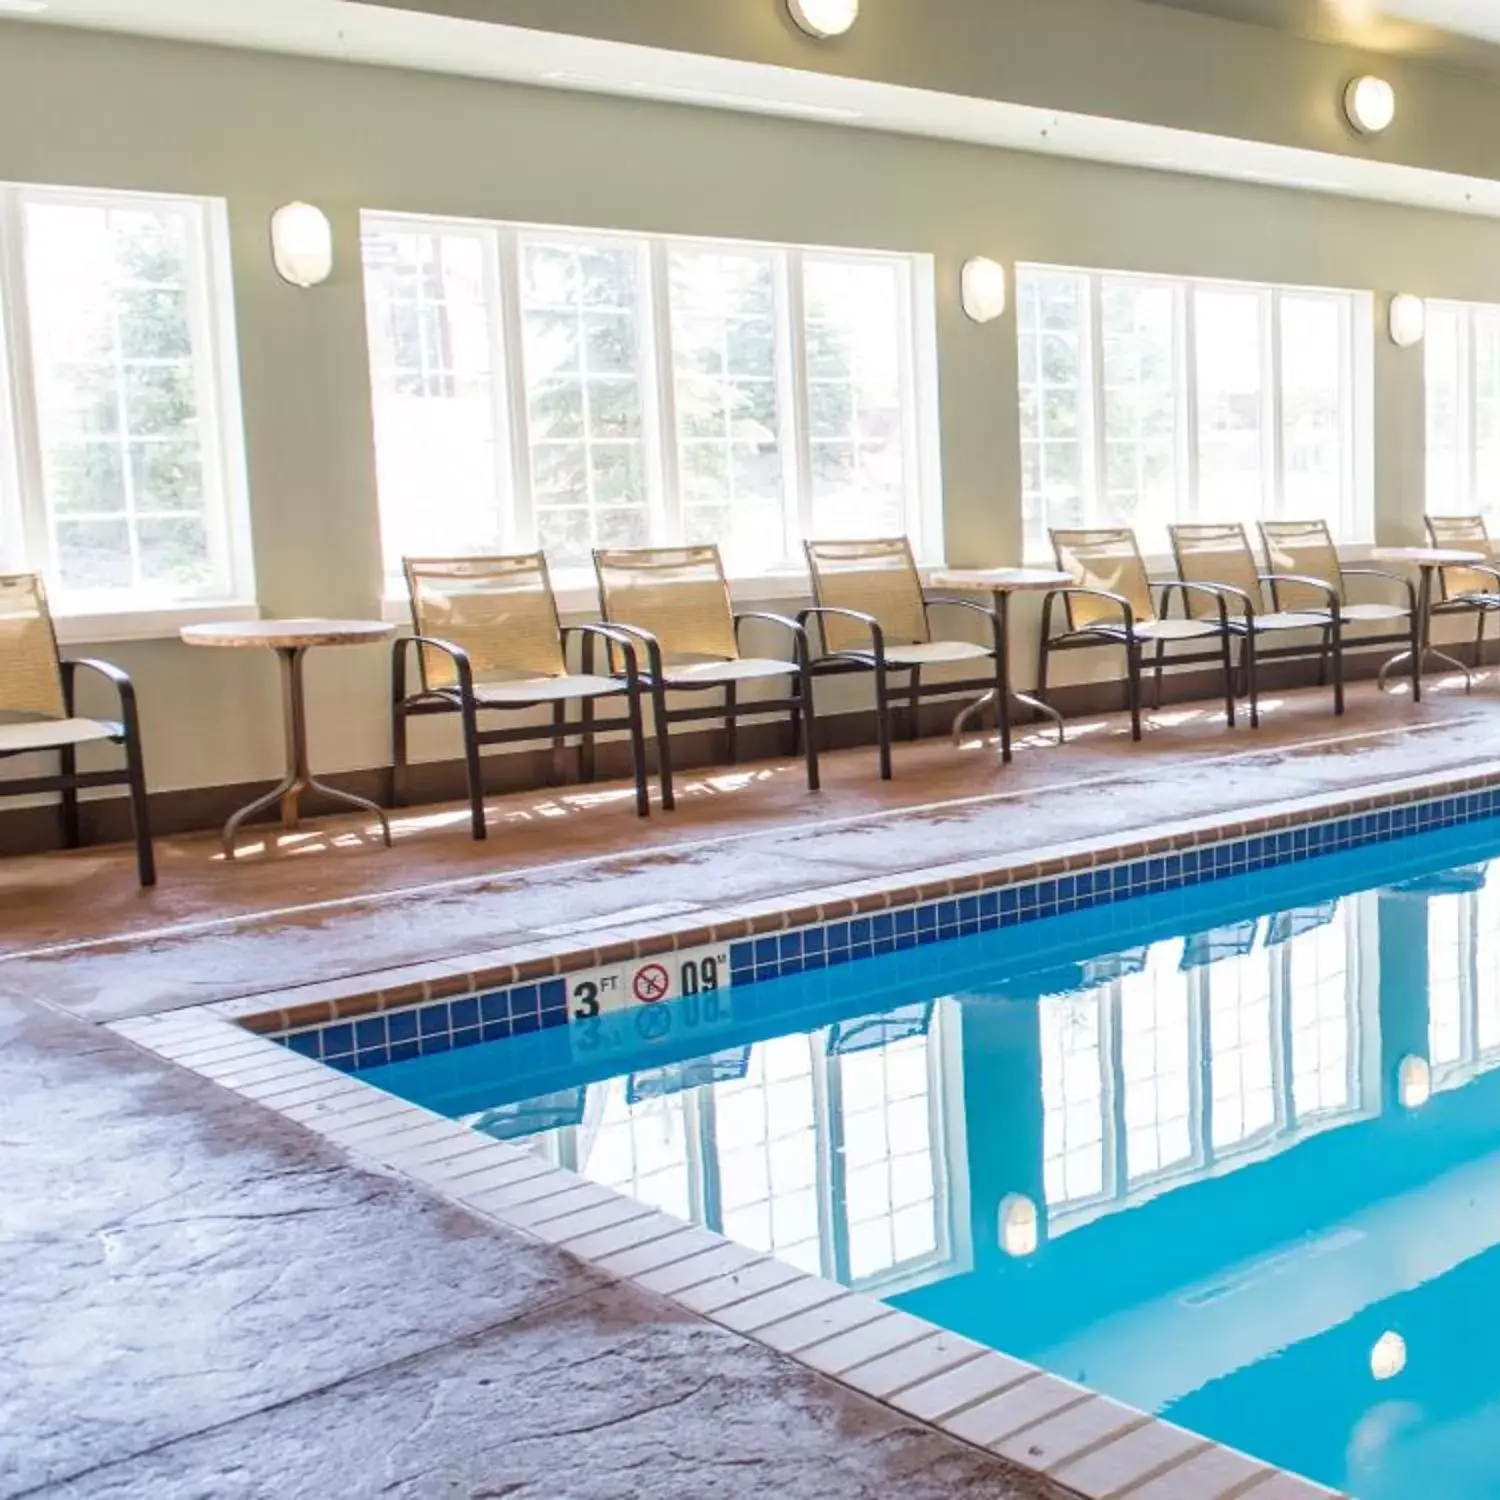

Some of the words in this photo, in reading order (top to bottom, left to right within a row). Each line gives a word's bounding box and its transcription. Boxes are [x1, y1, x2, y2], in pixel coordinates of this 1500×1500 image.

[573, 981, 599, 1019] 3
[601, 975, 618, 993] FT
[681, 956, 718, 997] 09
